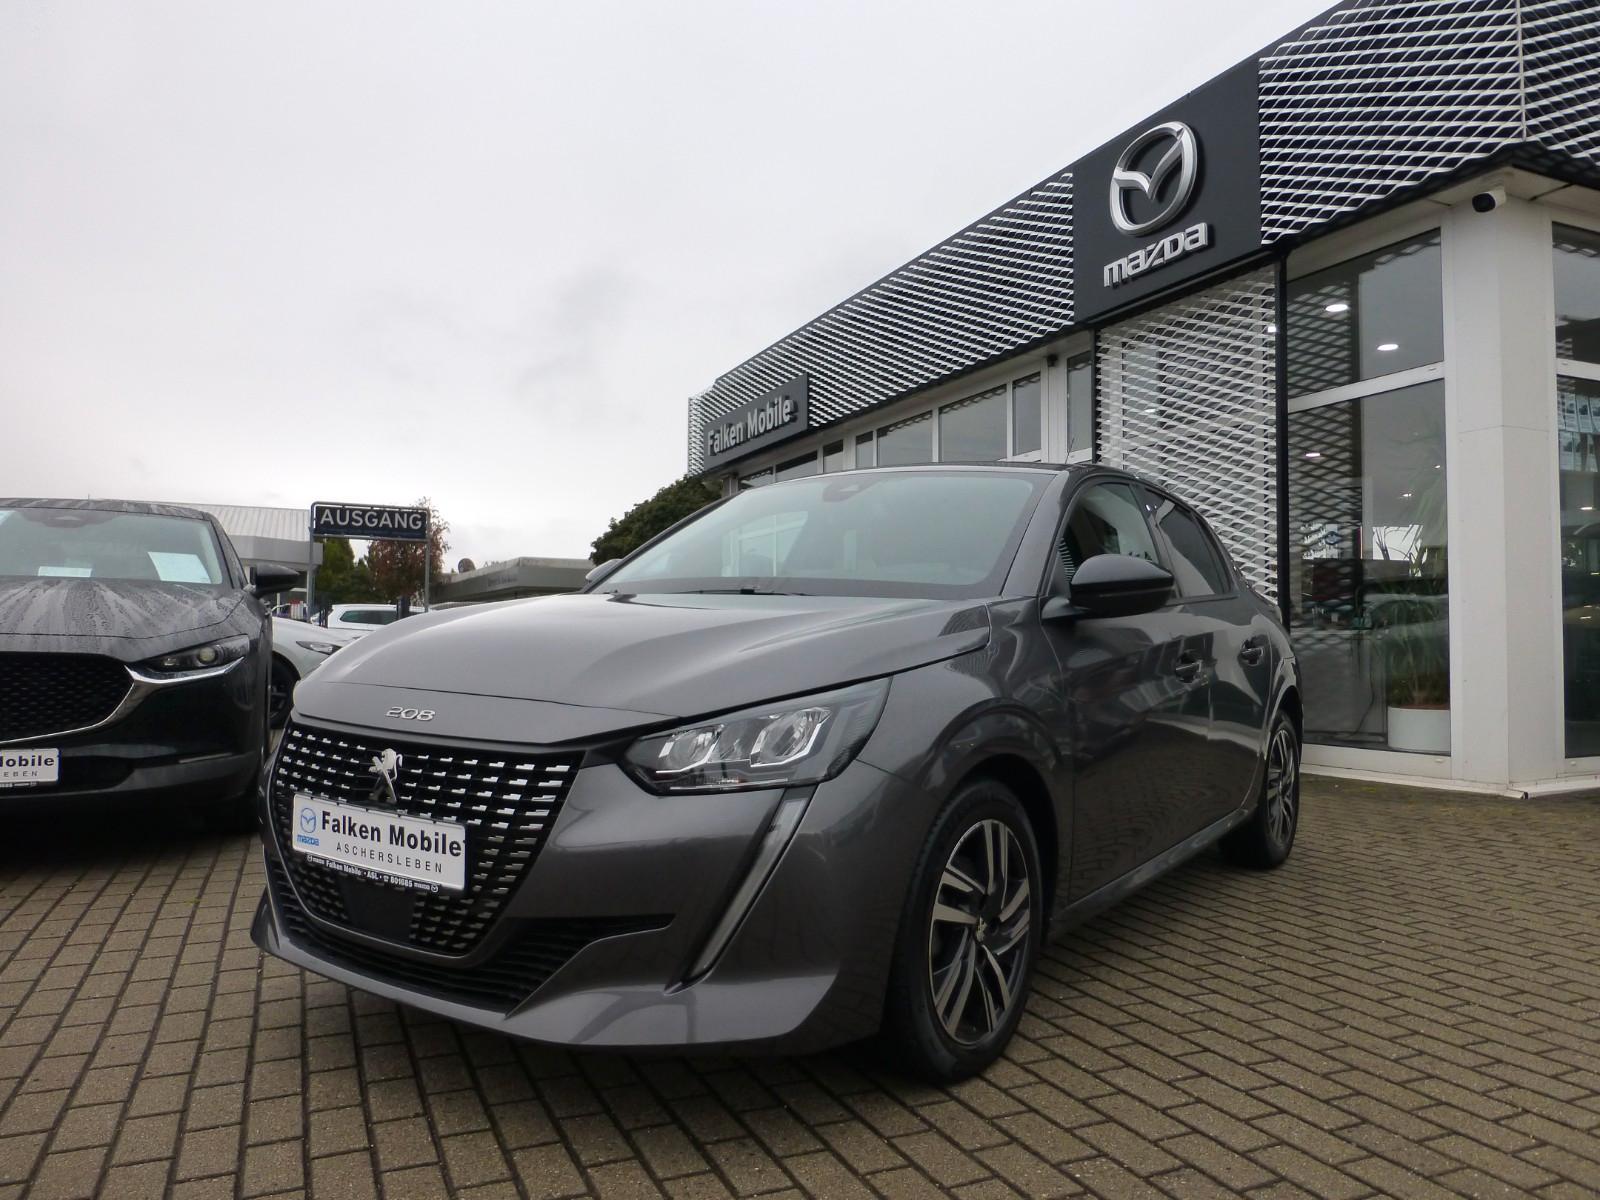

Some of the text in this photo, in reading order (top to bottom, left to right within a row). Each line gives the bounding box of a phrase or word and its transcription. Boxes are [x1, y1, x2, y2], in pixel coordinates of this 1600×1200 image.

[707, 396, 794, 456] Falken Mobile
[320, 509, 422, 530] AUSGANG
[386, 706, 436, 721] 208
[321, 810, 462, 857] Falken Mobile
[336, 842, 442, 873] ASCHERSLEBEN
